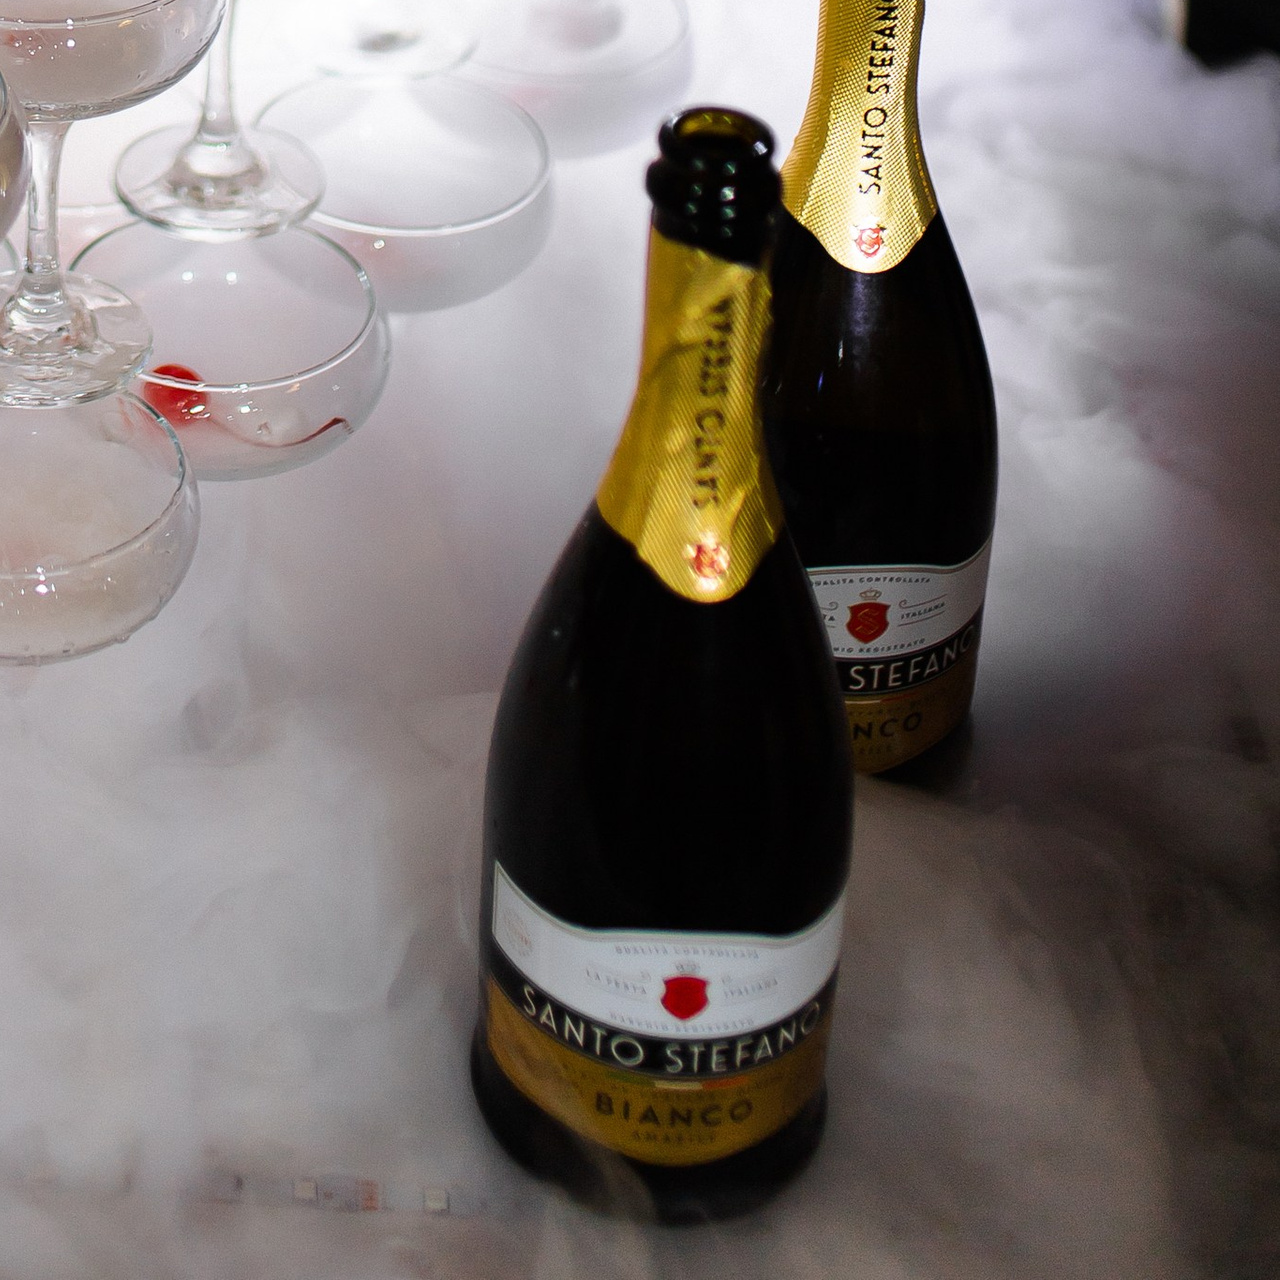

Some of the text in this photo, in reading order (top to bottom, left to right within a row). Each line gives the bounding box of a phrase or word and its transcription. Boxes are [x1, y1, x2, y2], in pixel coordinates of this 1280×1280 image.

[858, 105, 889, 196] SANTO
[813, 578, 854, 587] UALITA
[852, 711, 923, 742] NCO
[521, 984, 820, 1075] SANTO STEFANO
[594, 1090, 754, 1130] BIANCO
